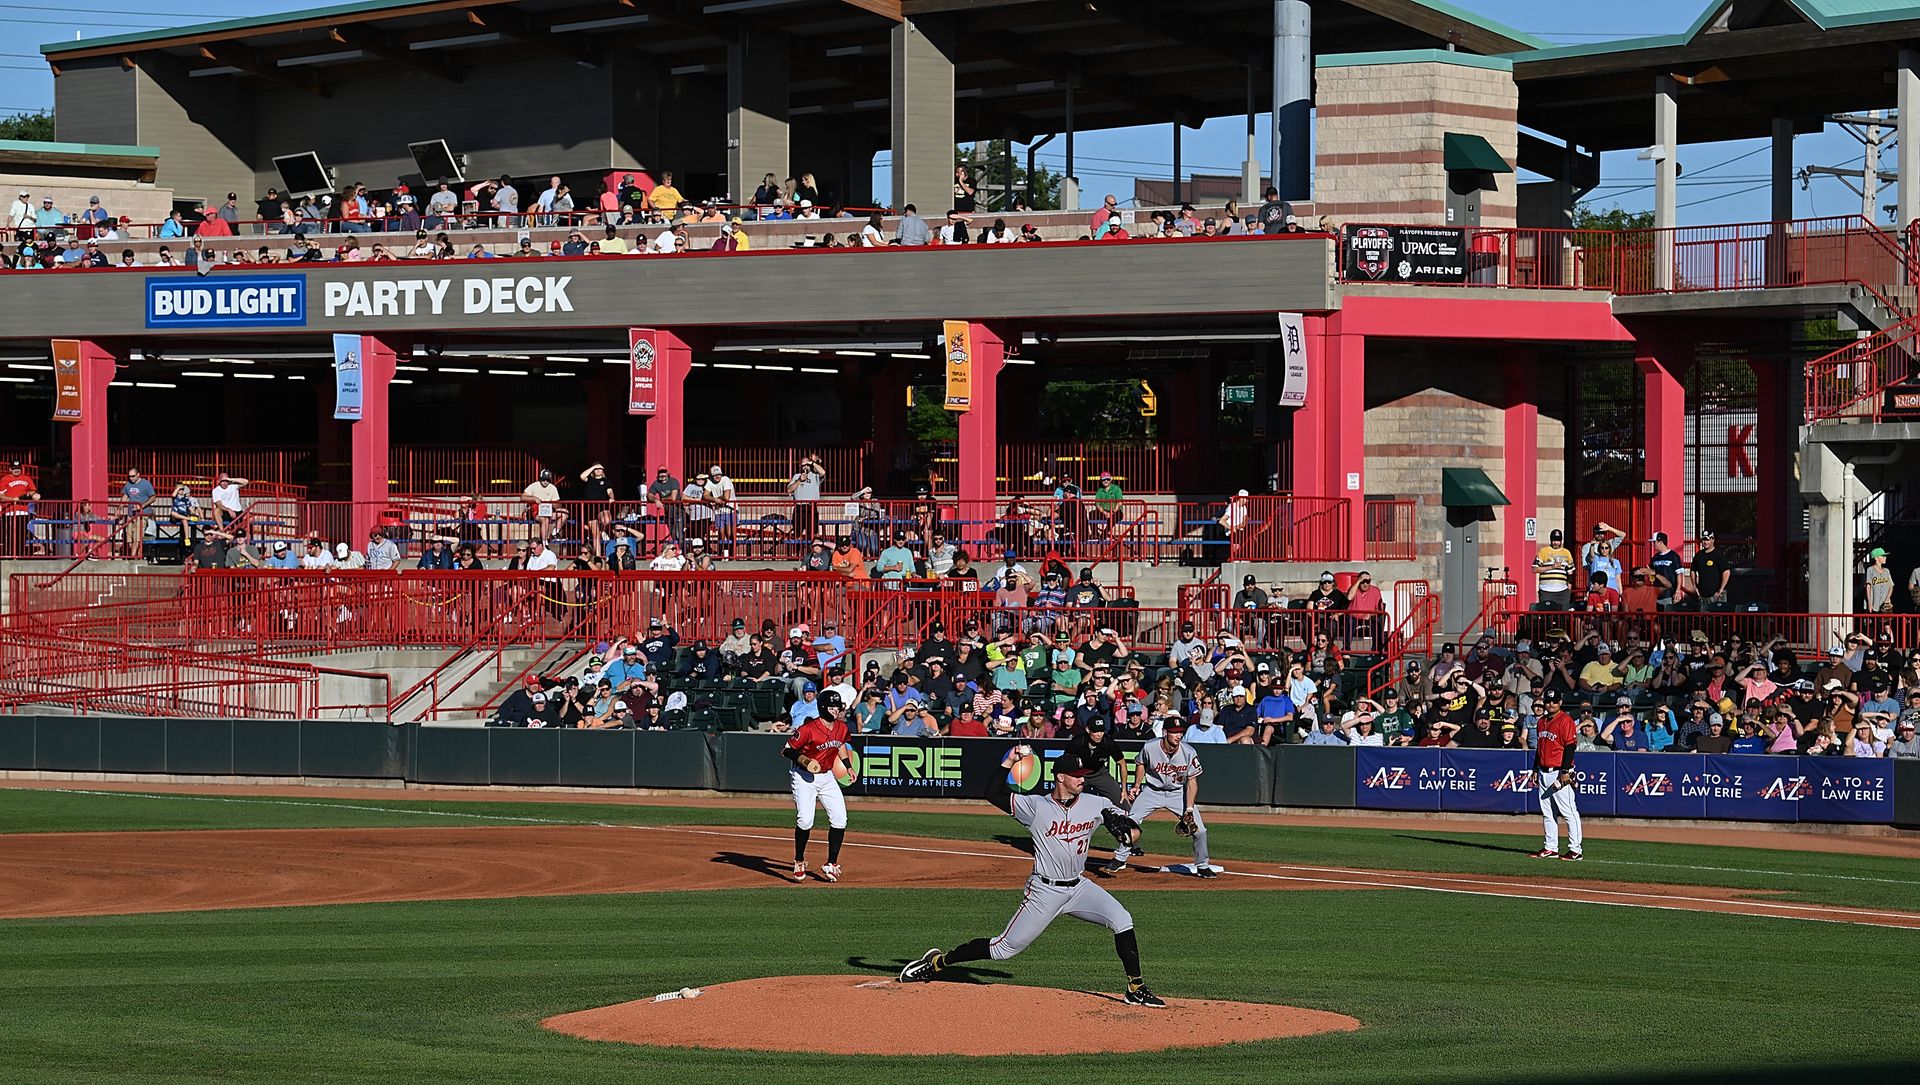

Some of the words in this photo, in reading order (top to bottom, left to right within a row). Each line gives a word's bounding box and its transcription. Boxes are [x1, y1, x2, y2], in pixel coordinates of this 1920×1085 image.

[1352, 237, 1393, 249] PLAYOFFS
[1402, 242, 1438, 255] UPMC
[1415, 266, 1463, 275] ARIENS
[154, 289, 212, 316] BUD
[324, 279, 452, 317] PARTY
[463, 276, 574, 314] DECK
[965, 582, 976, 591] 103
[1415, 585, 1426, 595] 103
[1505, 585, 1516, 594] 104
[862, 745, 963, 779] ERIE
[1154, 762, 1187, 774] Altoona
[1368, 766, 1405, 789] AZ
[1419, 767, 1429, 778] A
[1439, 767, 1456, 778] TO
[1468, 768, 1476, 779] Z
[1599, 772, 1607, 783] Z
[862, 778, 904, 786] ENERGY
[908, 779, 963, 788] PARTNERS
[1419, 780, 1446, 790] LAW
[1450, 780, 1476, 791] ERIE
[1628, 773, 1666, 796] AZ
[1681, 773, 1692, 784] A
[1703, 773, 1721, 785] TO
[1734, 775, 1743, 786] Z
[1822, 777, 1832, 787] A
[1843, 777, 1861, 788] TO
[1875, 778, 1884, 788] Z
[1580, 784, 1607, 795] ERIE
[1681, 786, 1710, 797] LAW
[1714, 787, 1743, 799] ERIE
[1764, 776, 1806, 801] AZ
[1821, 789, 1851, 800] LAW
[1855, 790, 1884, 801] ERIE
[1045, 819, 1094, 837] Altoona
